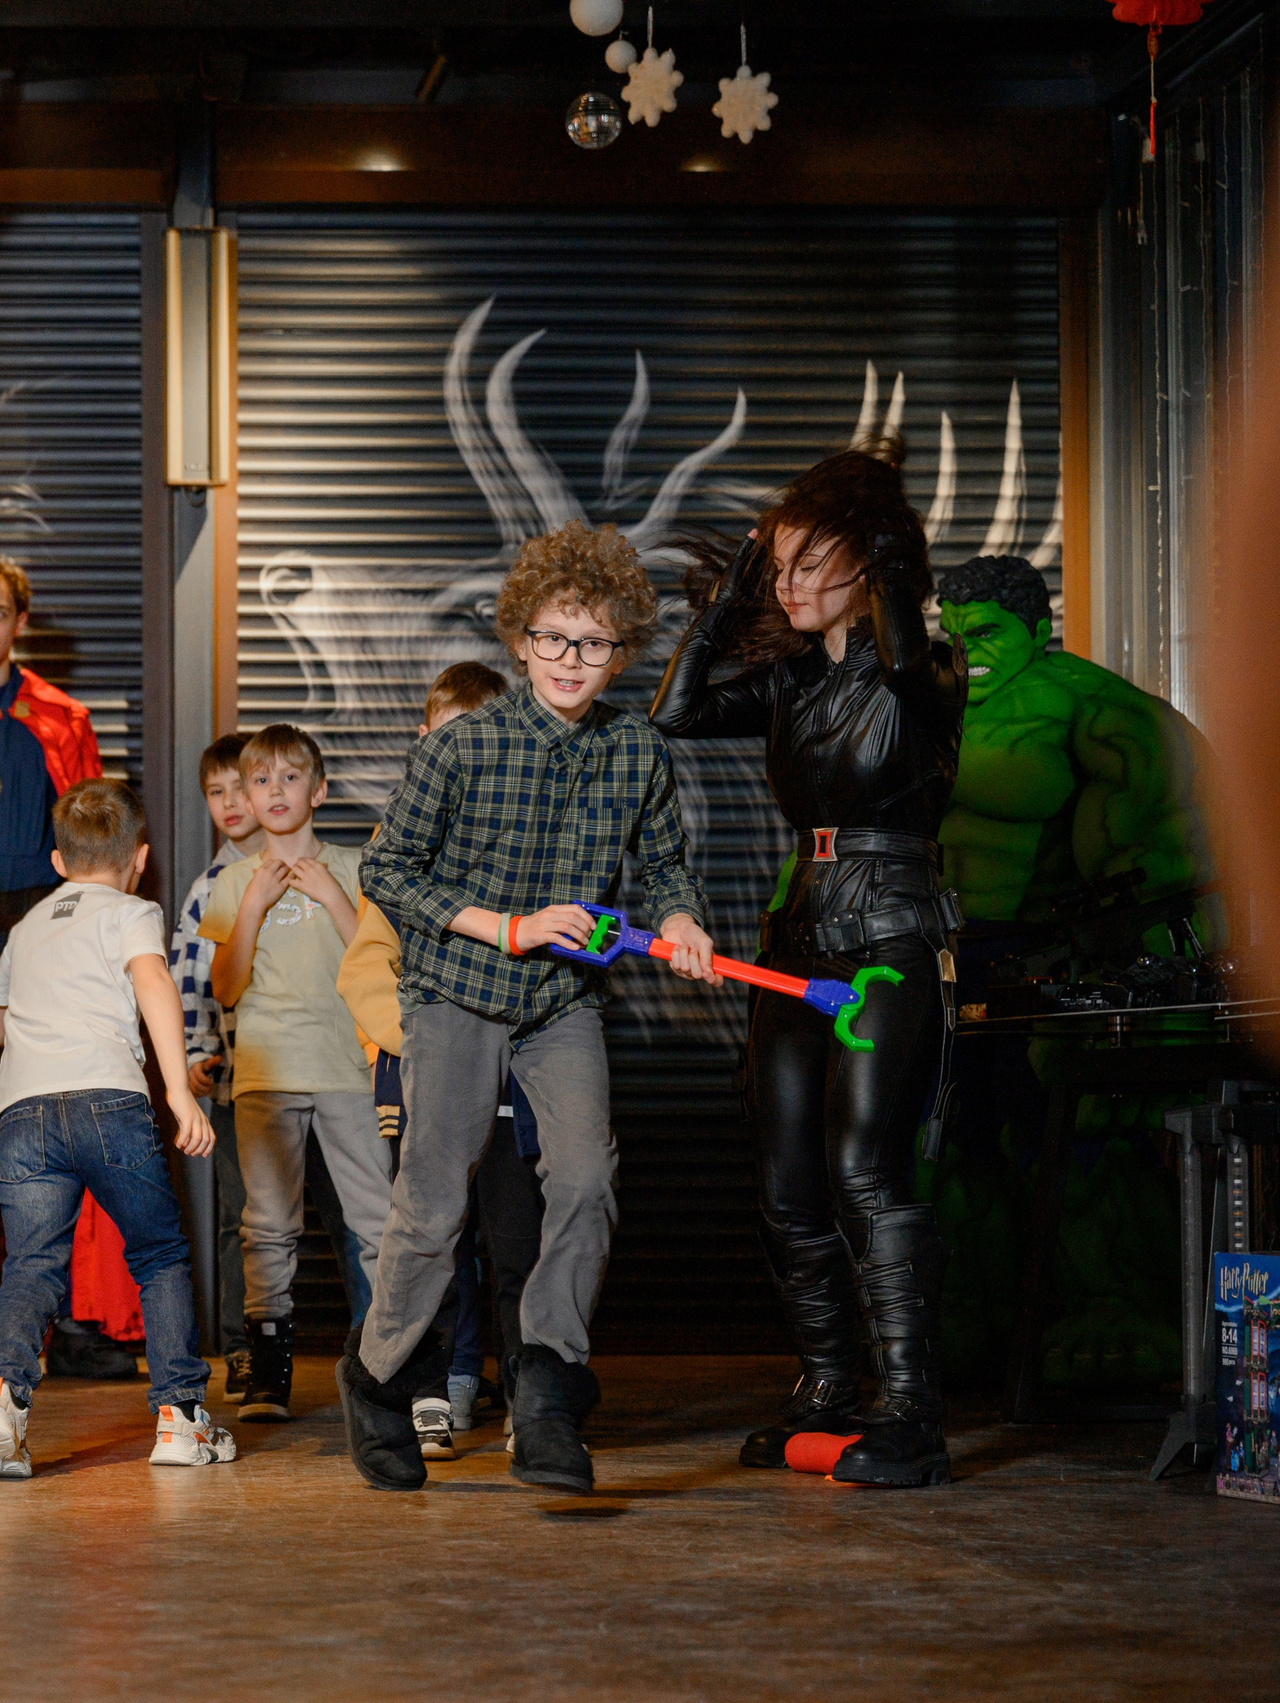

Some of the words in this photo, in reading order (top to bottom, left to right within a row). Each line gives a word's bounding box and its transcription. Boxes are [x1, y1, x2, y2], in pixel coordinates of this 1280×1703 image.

[1220, 1266, 1243, 1302] Harry
[1242, 1262, 1269, 1301] Potter
[1221, 1327, 1238, 1343] 8-14
